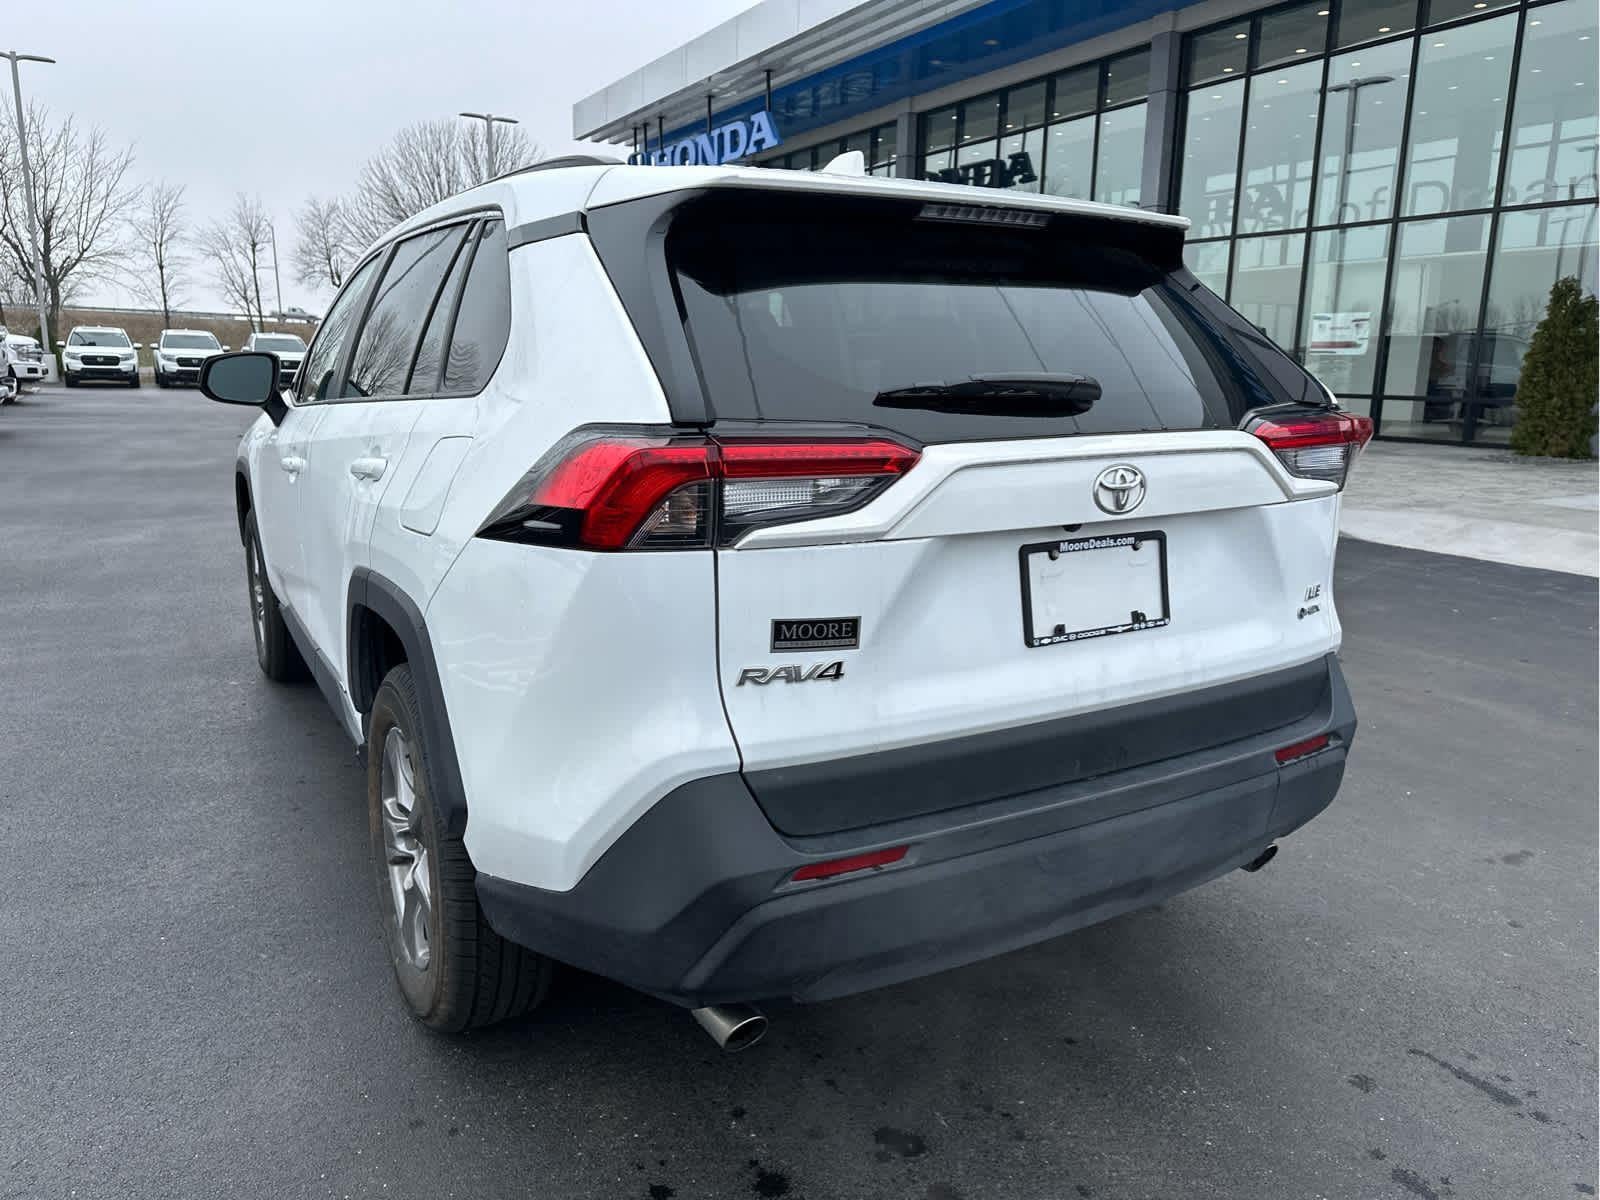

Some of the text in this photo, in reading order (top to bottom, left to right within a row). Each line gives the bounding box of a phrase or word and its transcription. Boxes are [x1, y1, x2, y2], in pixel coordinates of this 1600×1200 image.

[651, 110, 781, 166] HONDA
[1059, 537, 1135, 552] MooreDeals.com
[780, 622, 853, 640] MOORE
[736, 660, 845, 686] RAV4
